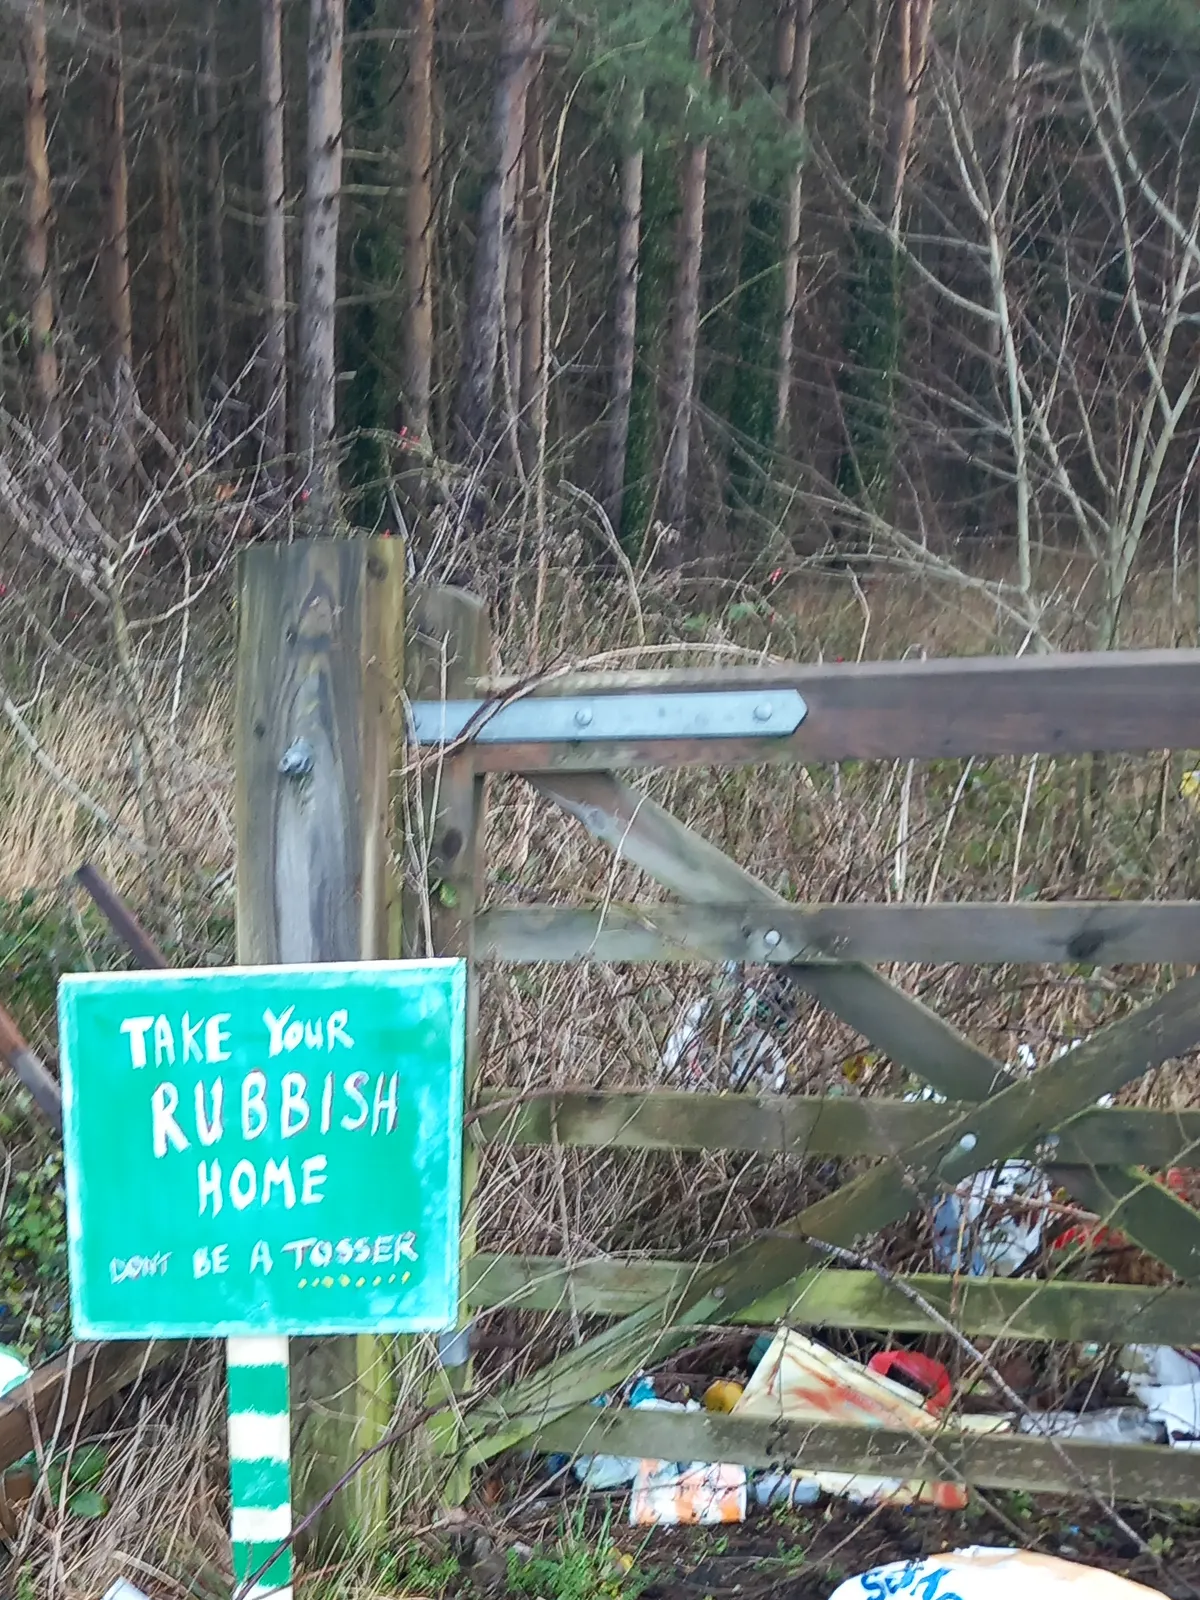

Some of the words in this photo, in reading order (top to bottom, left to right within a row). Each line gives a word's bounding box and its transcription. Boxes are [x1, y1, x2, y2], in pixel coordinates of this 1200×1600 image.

[120, 1011, 231, 1069] TAKE
[151, 1068, 400, 1158] RUBBISH
[198, 1155, 328, 1218] HOME
[192, 1243, 230, 1280] BE
[249, 1239, 274, 1276] A
[280, 1230, 419, 1271] TOSSER
